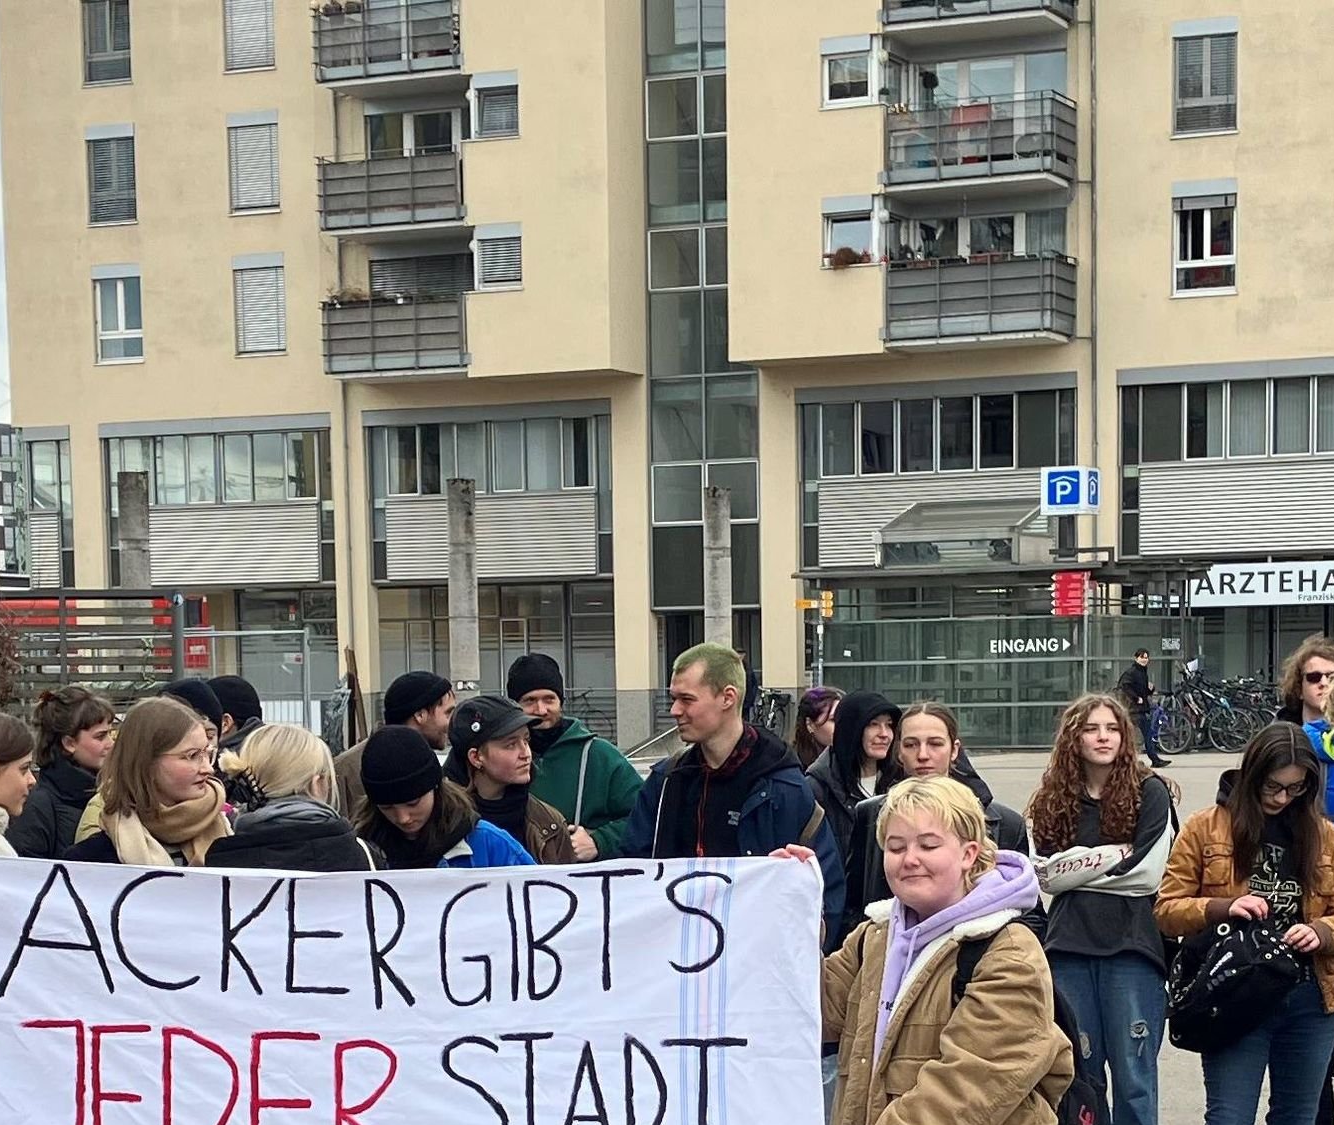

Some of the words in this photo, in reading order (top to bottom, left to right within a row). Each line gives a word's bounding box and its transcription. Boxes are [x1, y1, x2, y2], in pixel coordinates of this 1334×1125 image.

[1056, 481, 1072, 503] P
[990, 638, 1058, 653] EINGANG
[438, 862, 733, 1007] GIBT'S
